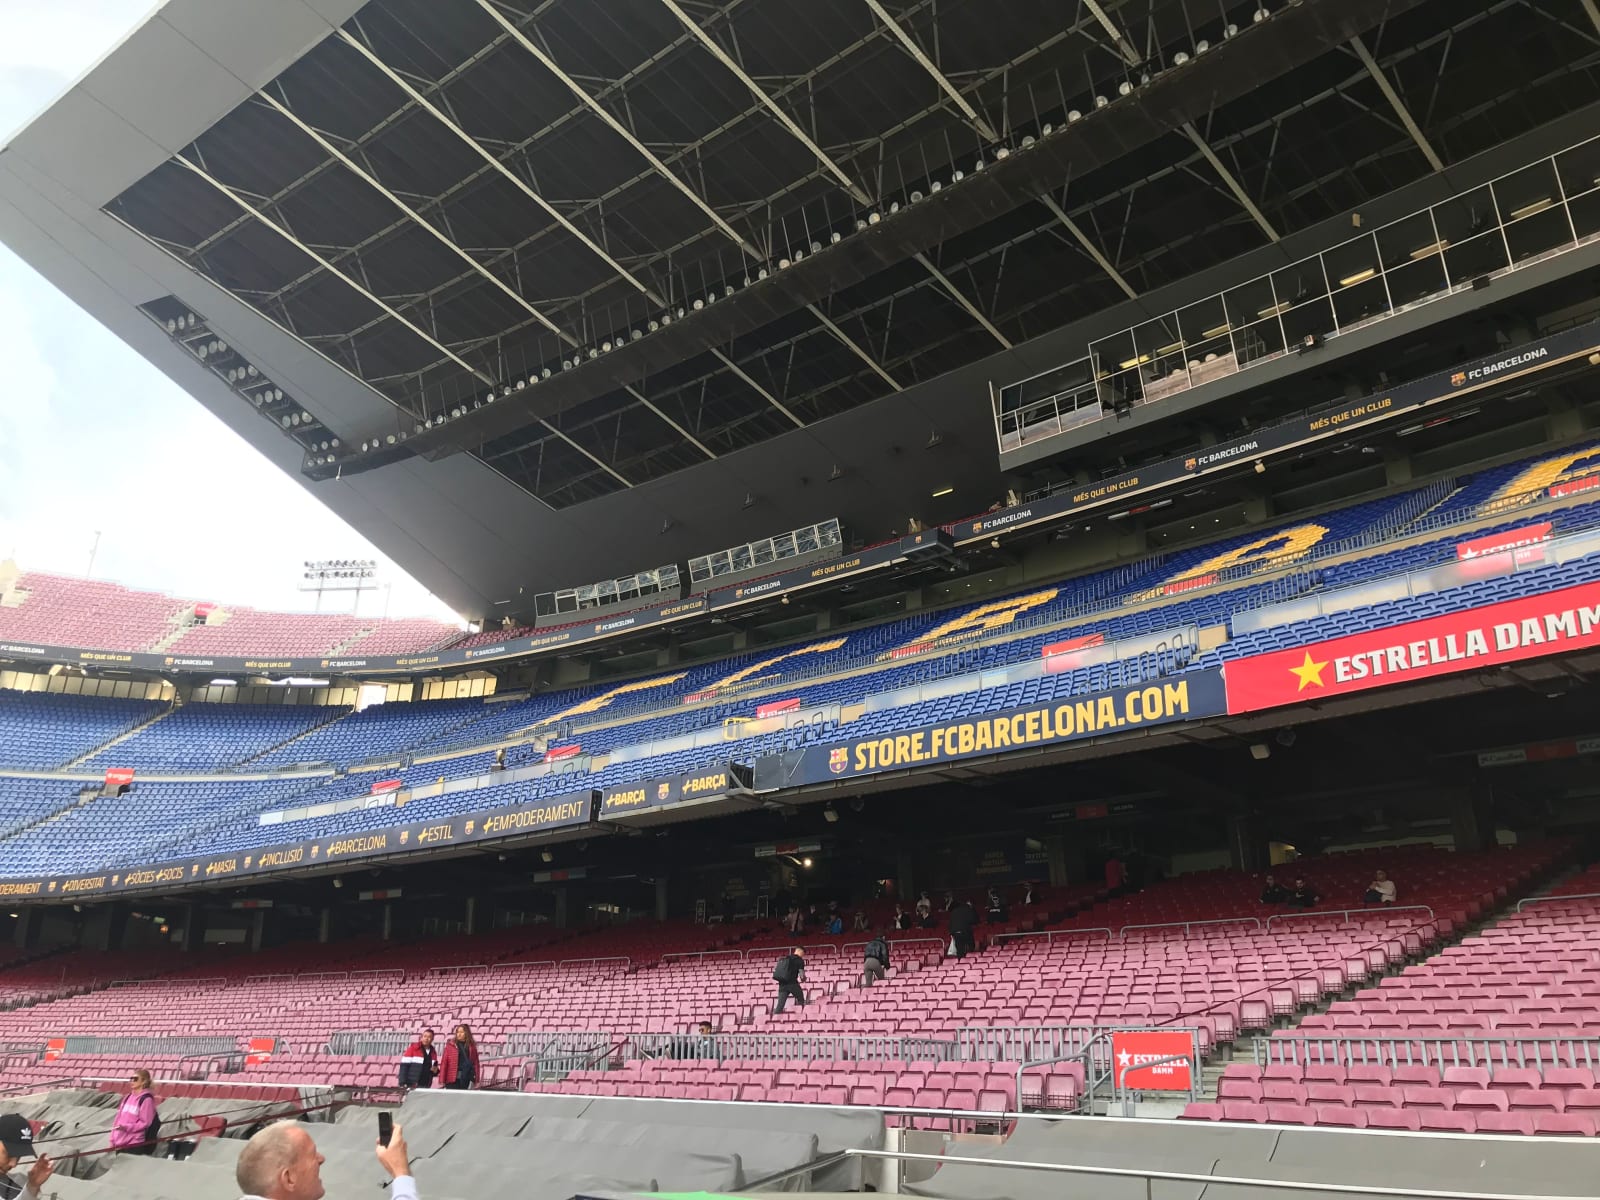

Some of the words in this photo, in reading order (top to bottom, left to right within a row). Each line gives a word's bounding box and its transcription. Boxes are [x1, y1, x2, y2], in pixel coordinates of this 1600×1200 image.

[1468, 367, 1482, 380] FC
[1483, 347, 1548, 376] BARCELONA
[1310, 417, 1330, 432] MÉS
[1331, 411, 1350, 425] QUE
[1351, 406, 1366, 418] UN
[1367, 398, 1392, 414] CLUB
[1198, 456, 1209, 466] FC
[1209, 441, 1258, 463] BARCELONA
[1073, 491, 1089, 503] MÉS
[1090, 487, 1106, 499] QUE
[1106, 484, 1118, 493] UN
[1118, 477, 1139, 491] CLUB
[983, 520, 992, 530] FC
[992, 509, 1032, 527] BARCELONA
[811, 568, 824, 577] MÉS
[824, 565, 835, 575] QUE
[836, 563, 844, 572] UN
[844, 558, 860, 570] CLUB
[743, 587, 751, 596] FC
[751, 580, 781, 593] BARCELONA
[660, 607, 671, 616] MÉS
[671, 605, 681, 614] QUE
[681, 604, 689, 612] UN
[689, 600, 702, 610] CLUB
[602, 623, 608, 631] FC
[608, 618, 635, 629] BARCELONA
[1334, 628, 1490, 684] ESTRELLA
[1493, 604, 1600, 653] DAMM
[80, 652, 94, 660] MÉS
[94, 653, 106, 661] QUE
[107, 653, 116, 661] UN
[182, 659, 214, 667] BARCELONA
[245, 660, 257, 668] MÉS
[855, 679, 1190, 772] STORE.FCBARCELONA.COM
[1152, 1067, 1173, 1075] DAMM
